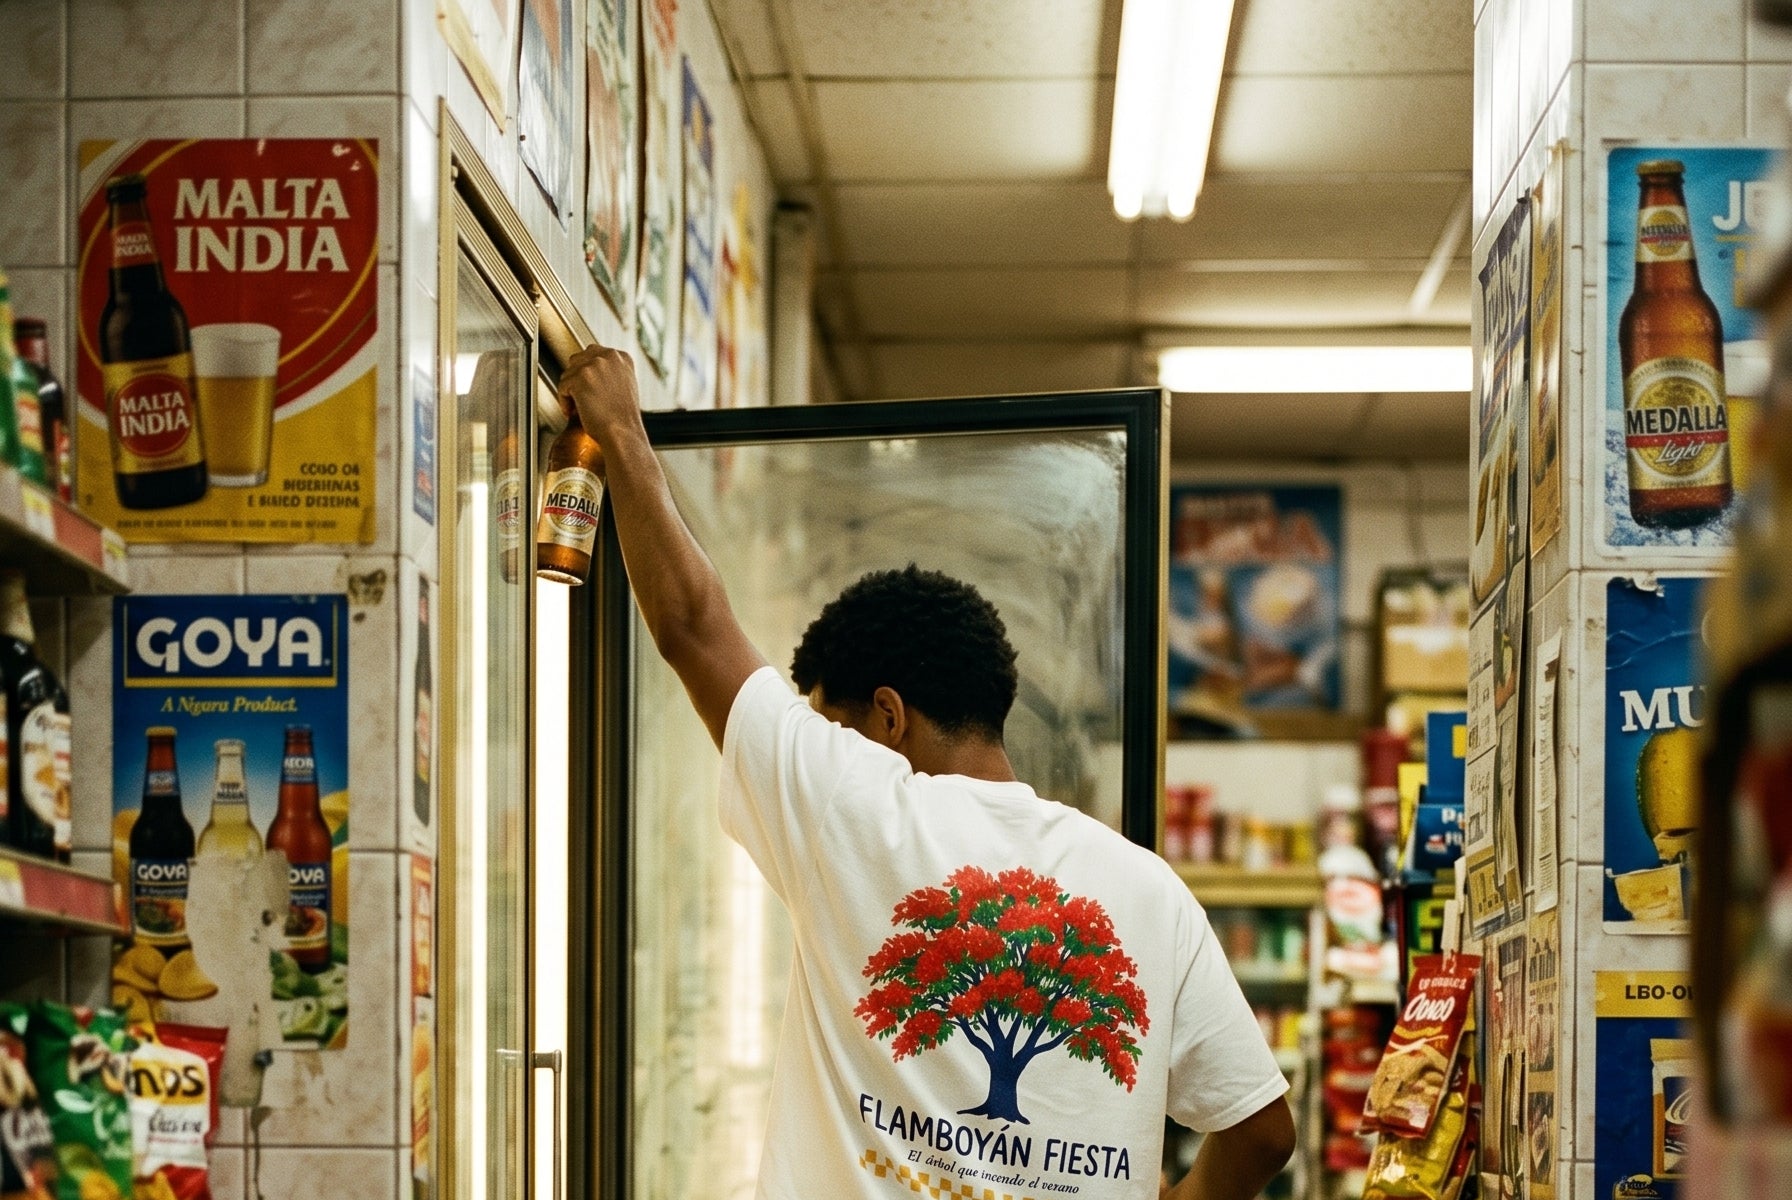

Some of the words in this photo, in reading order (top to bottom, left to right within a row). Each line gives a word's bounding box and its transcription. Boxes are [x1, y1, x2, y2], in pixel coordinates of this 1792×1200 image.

[174, 178, 350, 220] MALTA
[174, 226, 349, 272] INDIA
[119, 391, 185, 415] MALTA
[1626, 404, 1728, 434] MEDALLA
[120, 408, 190, 437] INDIA
[1656, 439, 1706, 466] Light
[136, 617, 323, 673] GOYA
[160, 696, 174, 712] A
[859, 1093, 1032, 1168] FLAMBOYÁN
[1043, 1138, 1130, 1180] FIESTA
[907, 1149, 922, 1163] El
[925, 1154, 957, 1173] árbol
[957, 1166, 979, 1180] que
[981, 1169, 1025, 1187] incendo
[1028, 1176, 1040, 1189] el
[1041, 1181, 1080, 1194] verano
